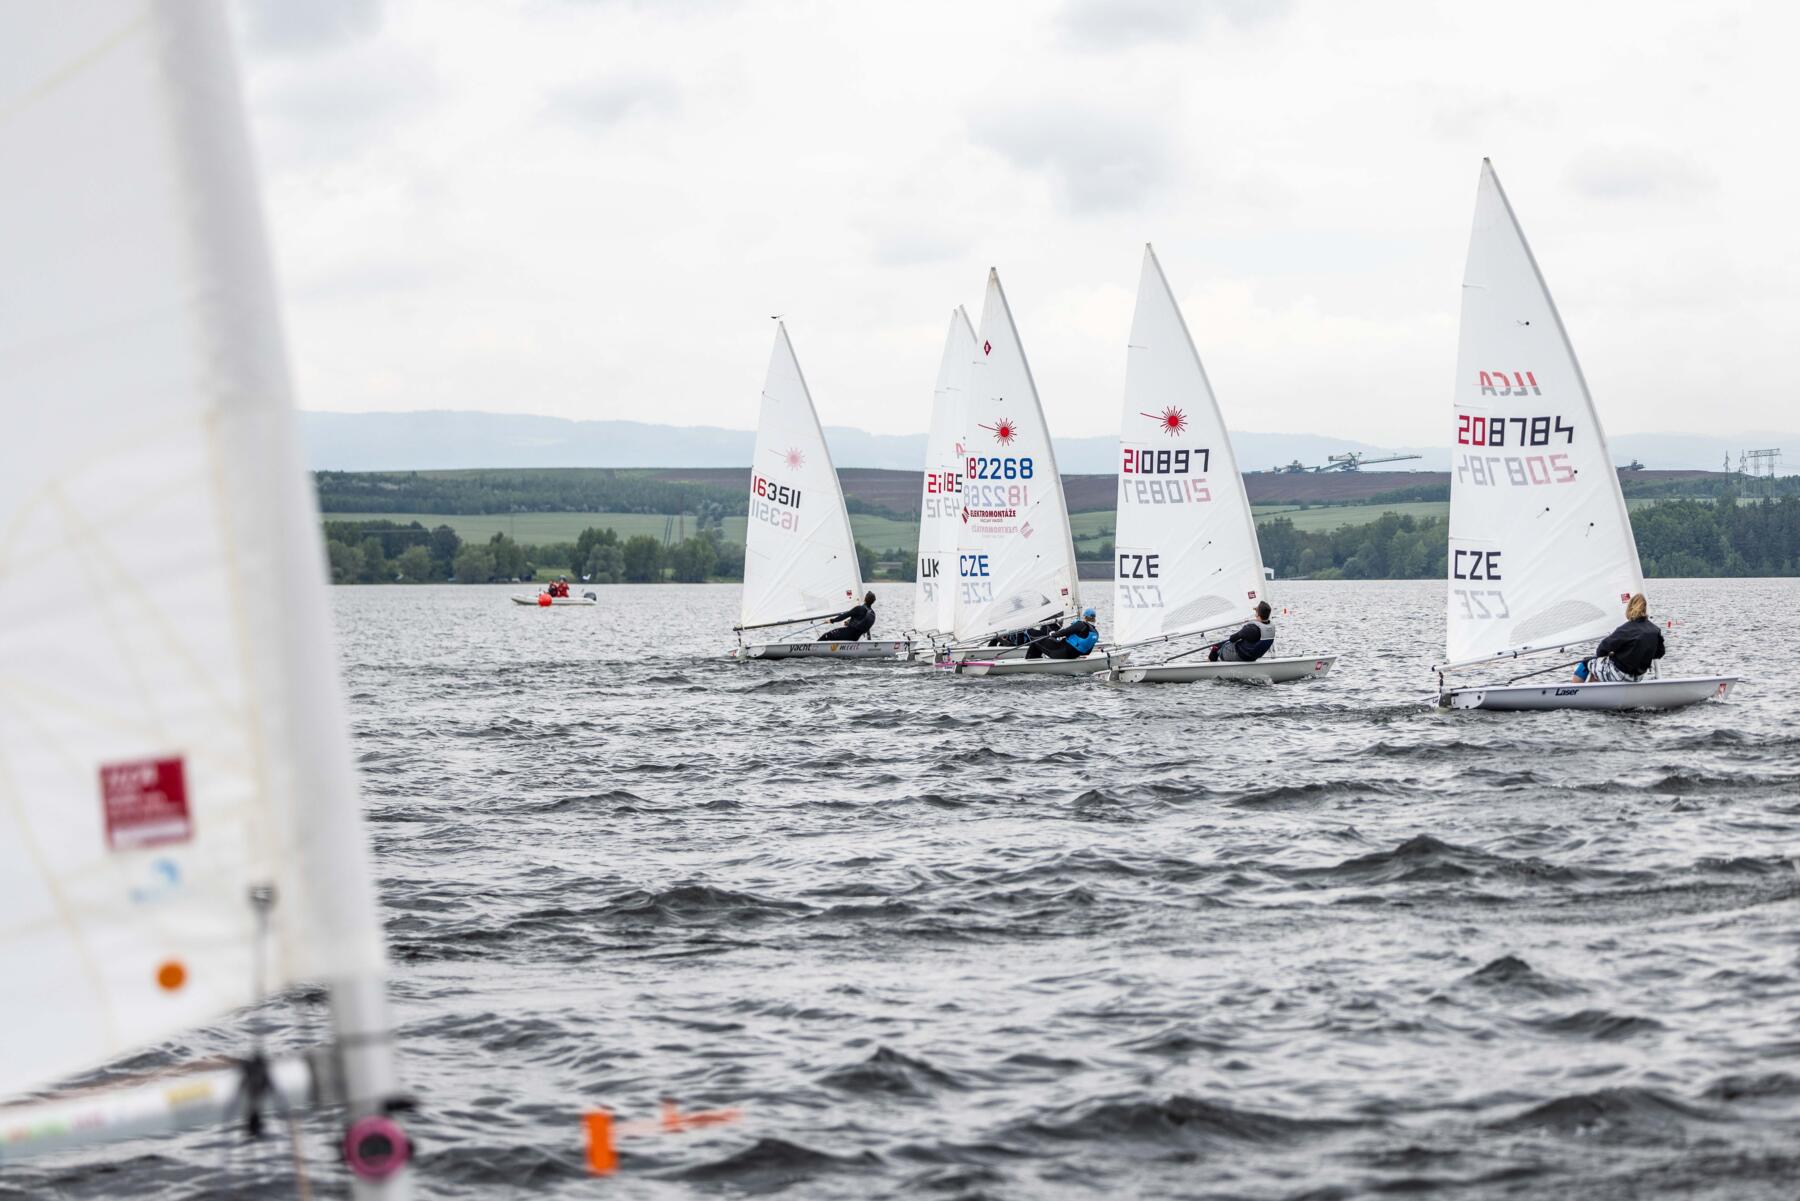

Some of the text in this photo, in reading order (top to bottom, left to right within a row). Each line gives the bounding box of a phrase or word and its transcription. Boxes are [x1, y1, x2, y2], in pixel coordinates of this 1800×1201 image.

[1458, 415, 1574, 447] 208784
[966, 457, 1034, 480] 182268
[1123, 449, 1210, 474] 210897
[753, 475, 801, 509] 163511
[970, 508, 1017, 517] ELEKTROMONTÁŽE
[959, 555, 990, 577] CZE
[1119, 554, 1159, 578] CZE
[1454, 550, 1502, 580] CZE
[1555, 688, 1580, 696] Laser
